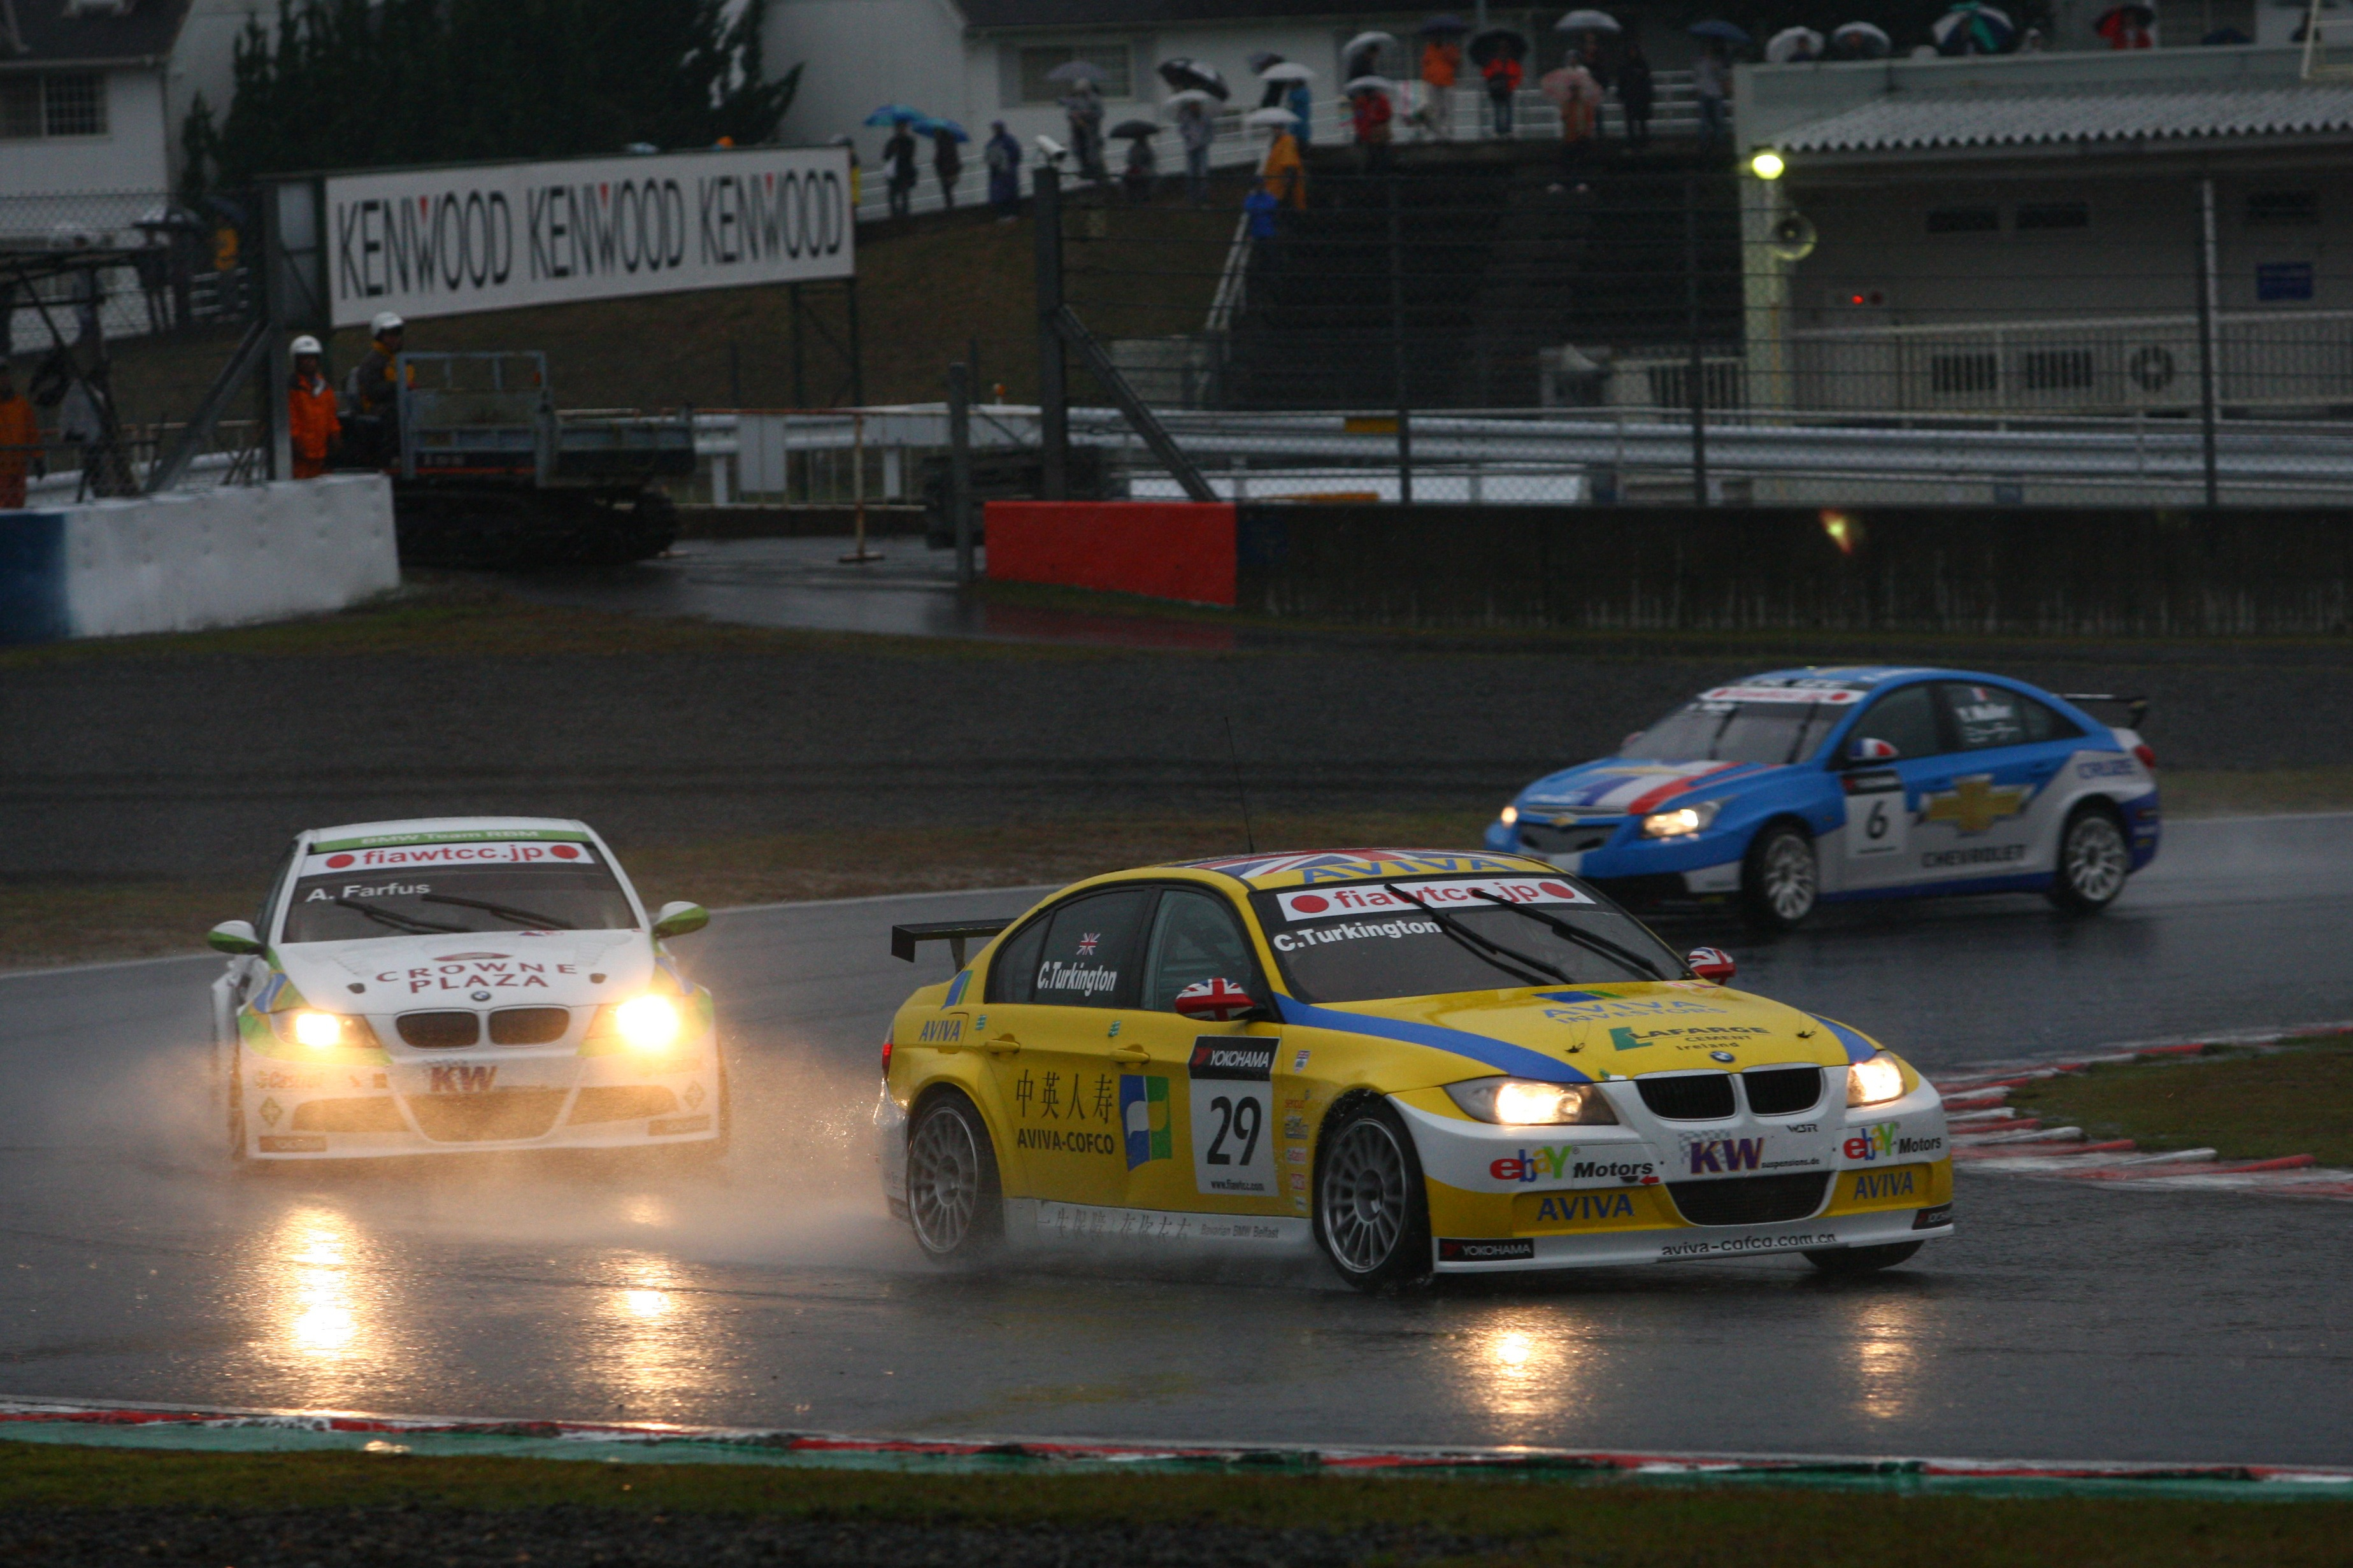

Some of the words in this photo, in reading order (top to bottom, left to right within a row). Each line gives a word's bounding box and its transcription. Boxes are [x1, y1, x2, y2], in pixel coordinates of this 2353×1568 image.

[338, 190, 511, 300] KENWOOD
[527, 177, 685, 282] KENWOOD
[699, 169, 842, 266] KENWOOD
[1866, 799, 1888, 839] 6
[361, 834, 419, 845] BMW
[364, 843, 543, 865] fiawtcc.jp
[1303, 859, 1517, 884] AVIVA
[305, 888, 334, 902] A.
[342, 882, 431, 899] Farfus
[1273, 920, 1443, 951] C.Turkington
[376, 962, 578, 983] CROWNE
[410, 973, 549, 994] PLAZA
[1037, 961, 1118, 997] C.Turkington
[1541, 1001, 1708, 1018] AVIVA
[1556, 1008, 1728, 1024] INVESTORS
[919, 1020, 961, 1041] AVIVA
[1675, 1041, 1740, 1051] Ireland
[1211, 1050, 1270, 1068] YOKOHAMA
[429, 1066, 497, 1092] KW
[1016, 1069, 1113, 1124] 中英人寿
[1017, 1128, 1115, 1155] AVIVA-COFCO
[1207, 1096, 1262, 1166] 29
[1691, 1137, 1764, 1174] KW
[1898, 1135, 1942, 1155] Motors
[1573, 1161, 1654, 1178] Motors
[1854, 1171, 1913, 1201] AVIVA
[1537, 1194, 1635, 1222] AVIVA
[1462, 1244, 1532, 1256] YOKOHAMA
[1661, 1232, 1836, 1255] aviva-cofco.com.cn
